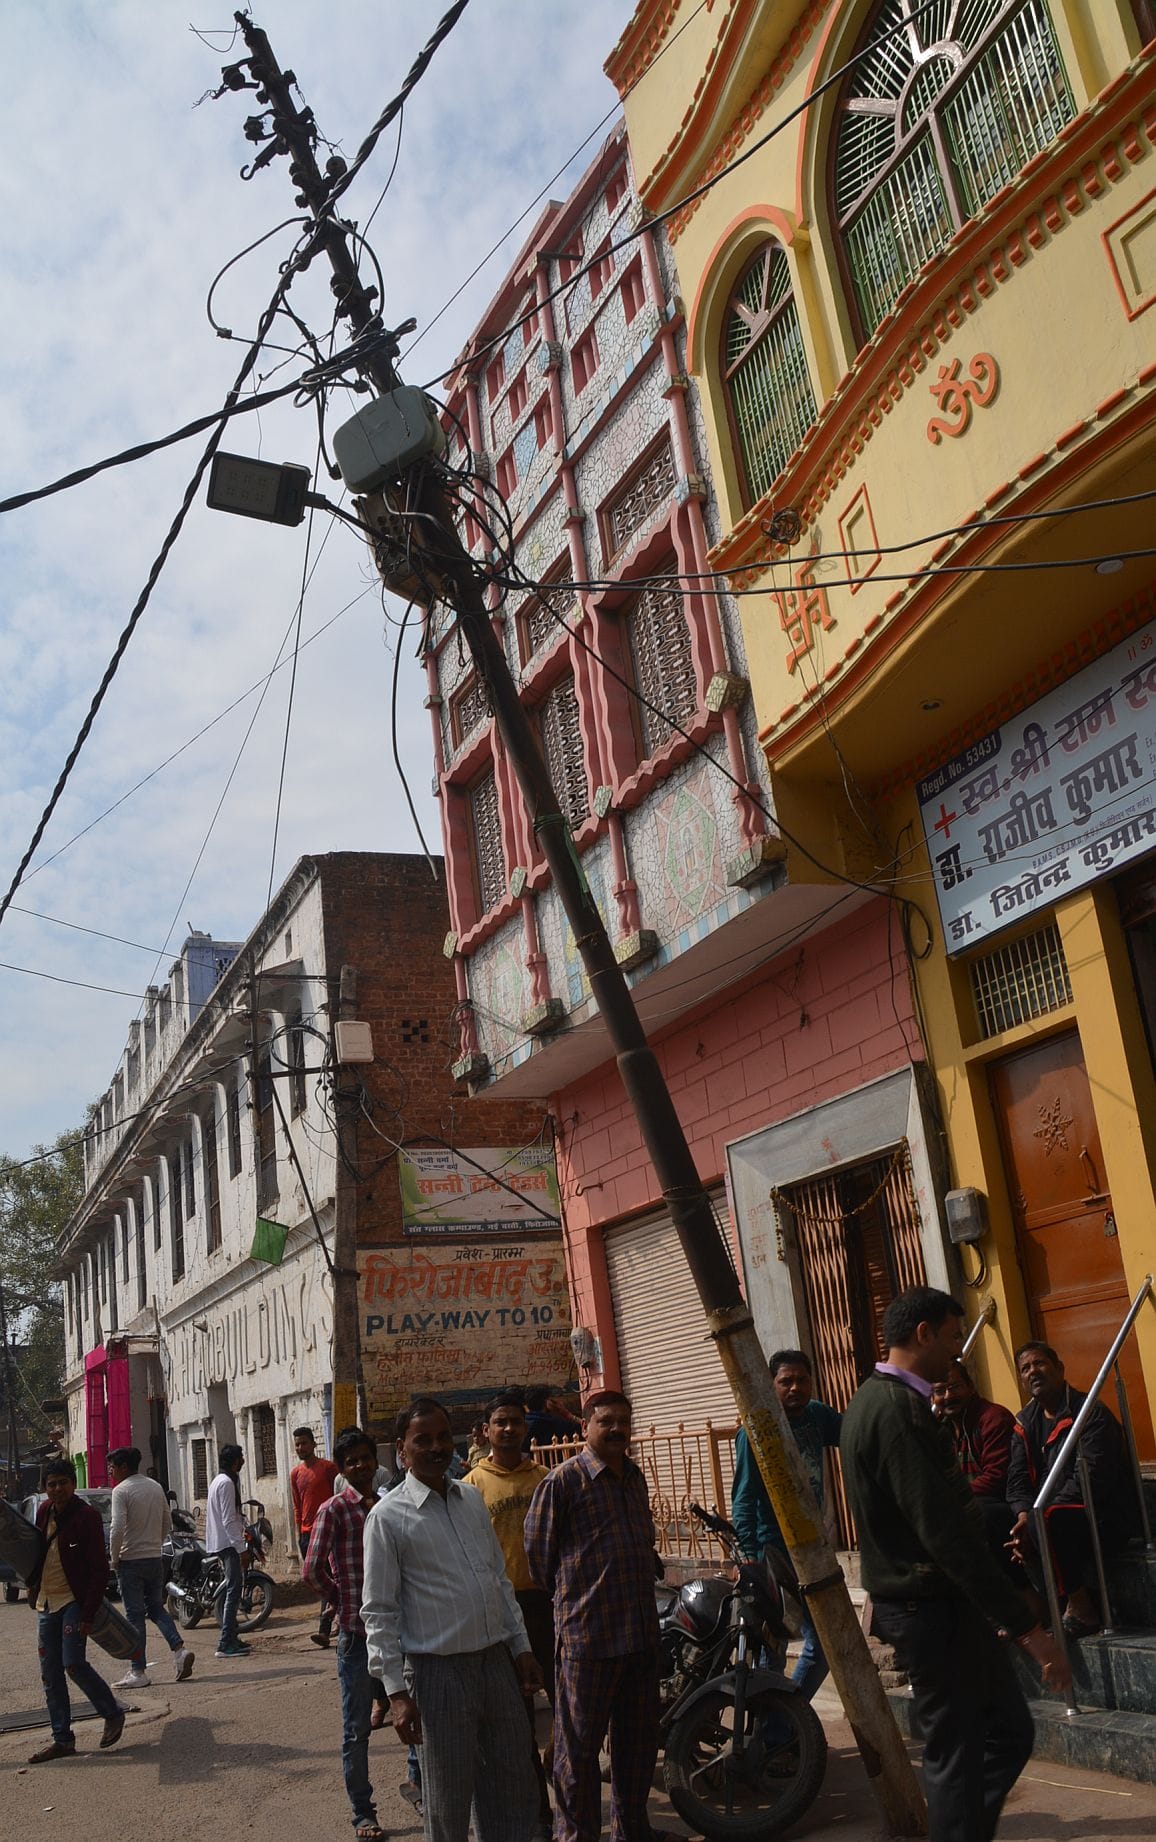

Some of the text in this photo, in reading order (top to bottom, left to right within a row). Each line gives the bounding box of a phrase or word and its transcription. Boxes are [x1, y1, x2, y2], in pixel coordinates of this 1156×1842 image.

[1055, 686, 1117, 754] राम
[920, 734, 998, 797] Regd. No. 53431
[936, 732, 1144, 892] डा. राजीव कुमार
[948, 911, 982, 941] डा.
[989, 856, 1071, 918] जितेन्द्र
[361, 1255, 531, 1306] फिरोजाबाद
[495, 1306, 526, 1328] TO
